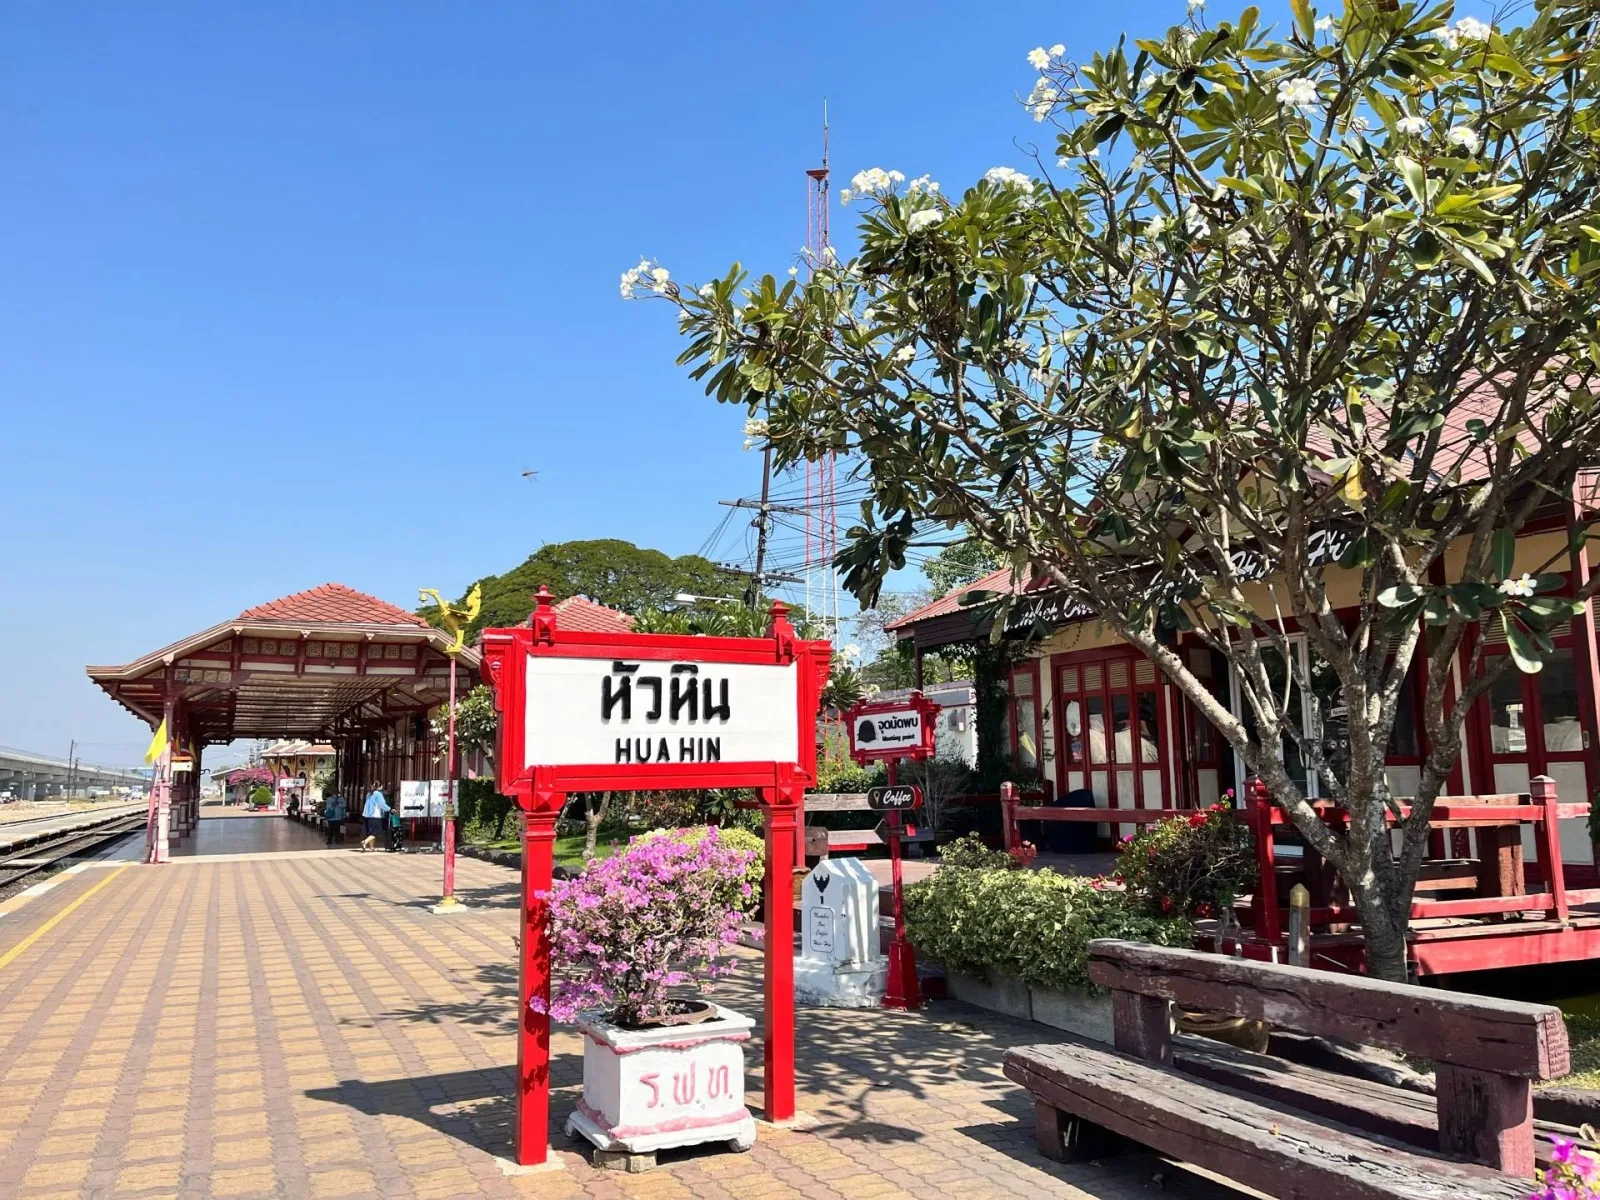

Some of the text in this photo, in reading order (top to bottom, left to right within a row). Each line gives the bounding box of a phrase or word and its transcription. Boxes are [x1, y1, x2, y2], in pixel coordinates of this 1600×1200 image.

[601, 661, 731, 724] หัวหิน
[878, 716, 918, 734] จุดนัดพบ
[615, 737, 721, 763] HUA HIN
[882, 789, 912, 806] Coffee
[819, 895, 824, 905] 1
